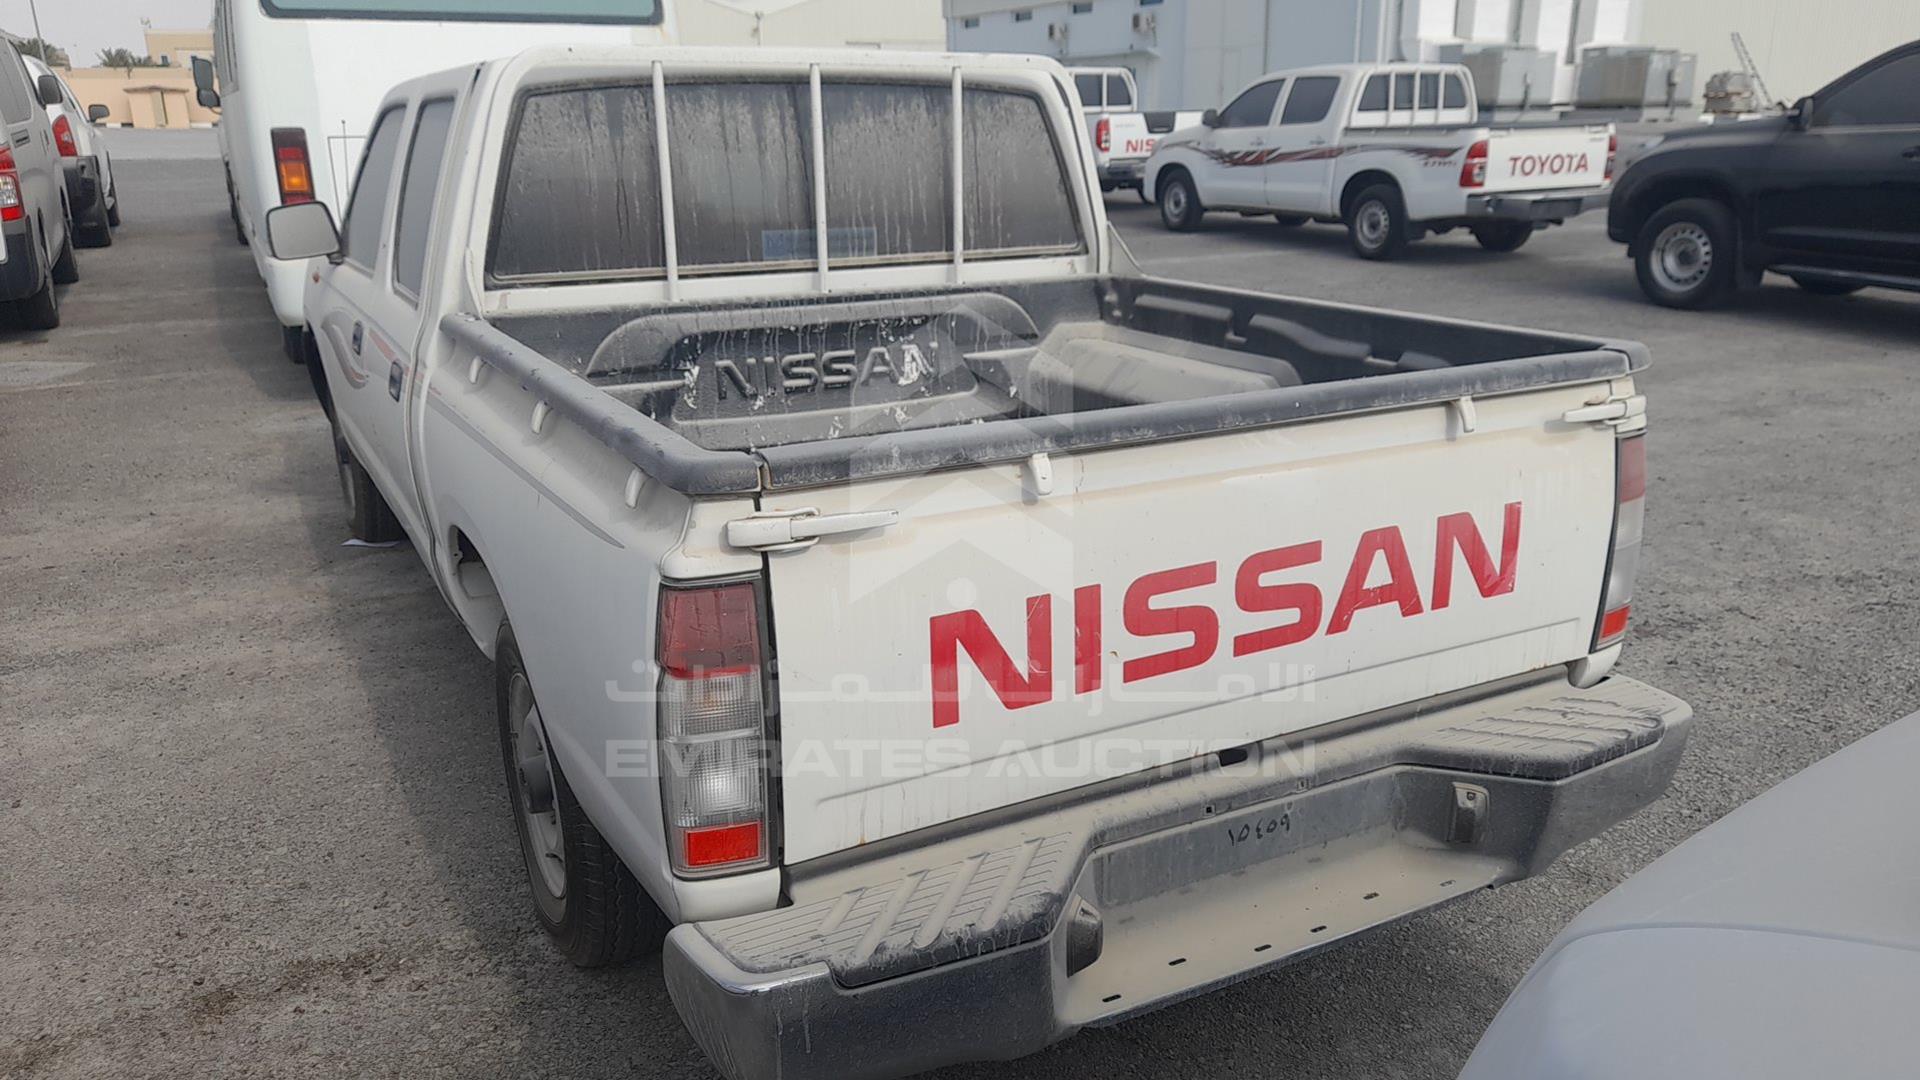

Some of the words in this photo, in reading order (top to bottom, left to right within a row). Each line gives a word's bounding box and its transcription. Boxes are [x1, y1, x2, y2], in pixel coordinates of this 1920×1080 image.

[1509, 153, 1589, 177] TOYOTA
[715, 342, 938, 400] NISSAN
[929, 501, 1523, 729] NISSAN
